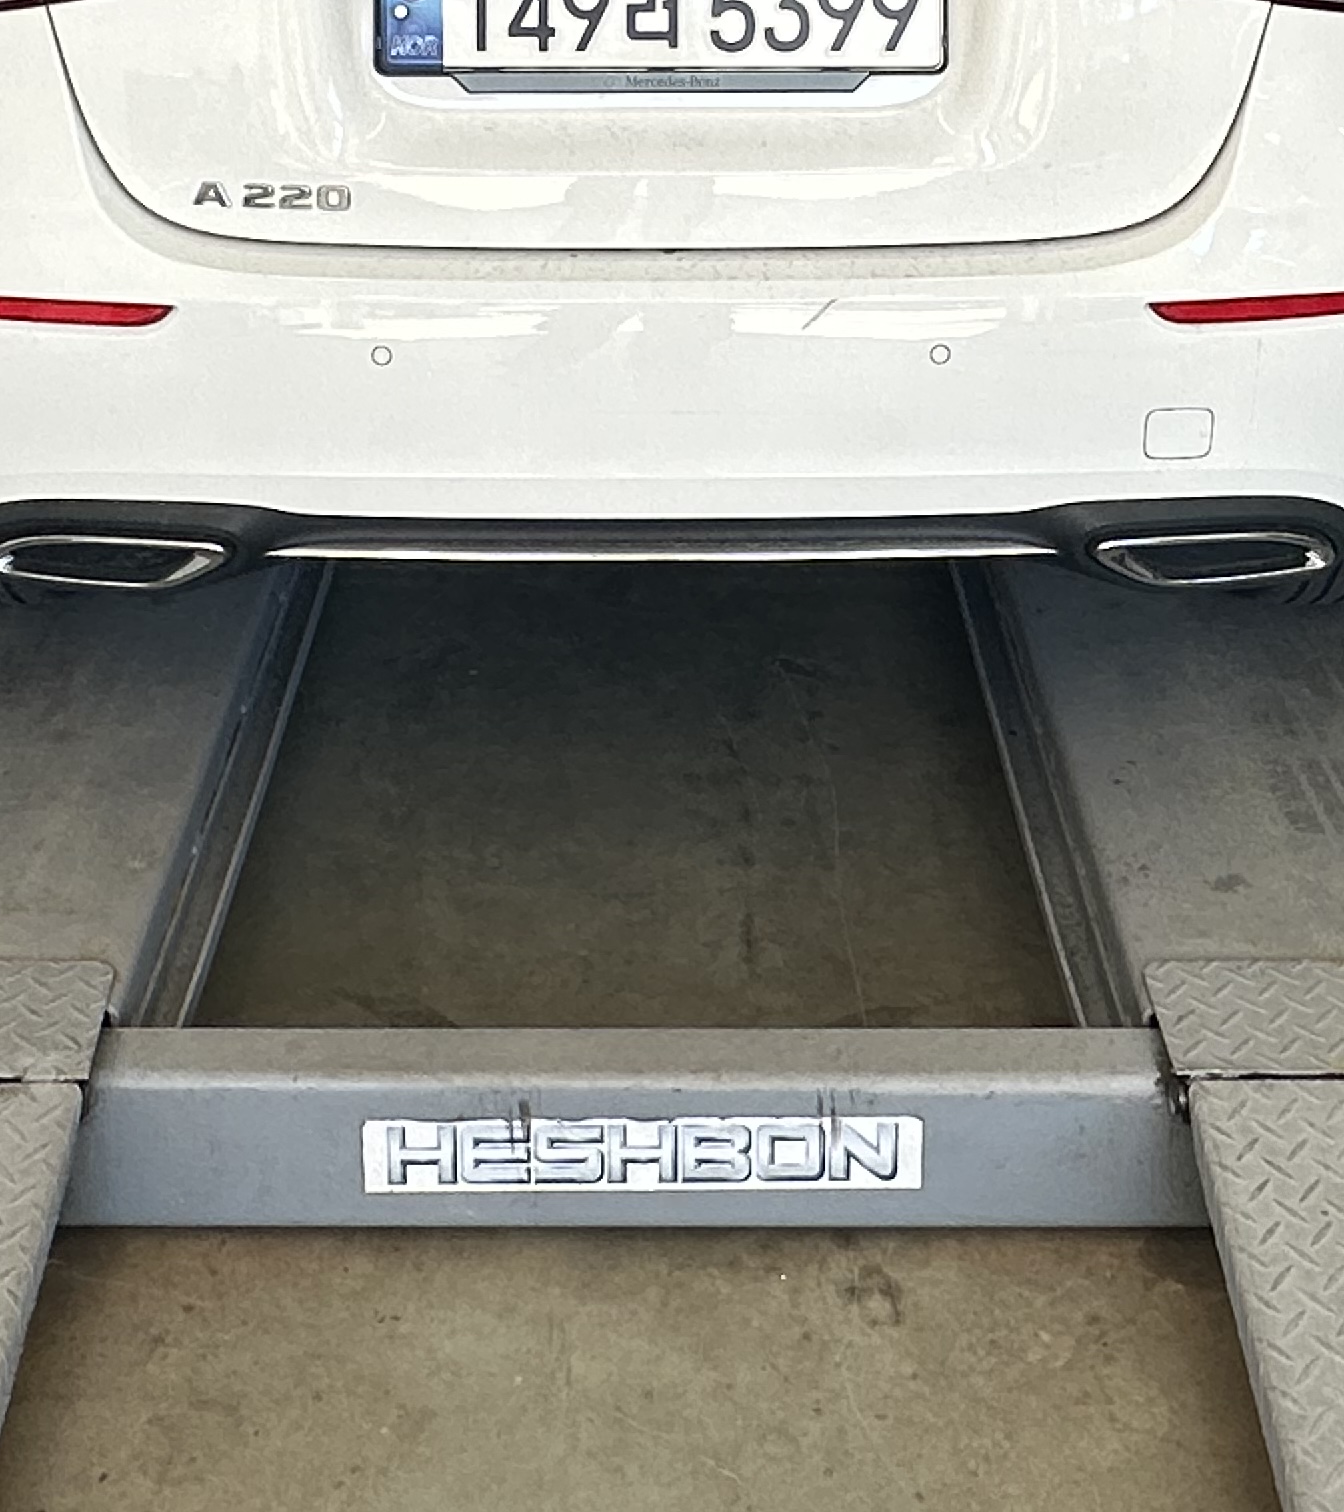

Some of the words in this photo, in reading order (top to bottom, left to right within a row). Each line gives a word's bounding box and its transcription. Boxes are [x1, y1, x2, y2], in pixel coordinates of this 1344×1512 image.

[193, 180, 233, 209] A
[242, 182, 352, 211] 220
[386, 1122, 899, 1186] HESHBON
